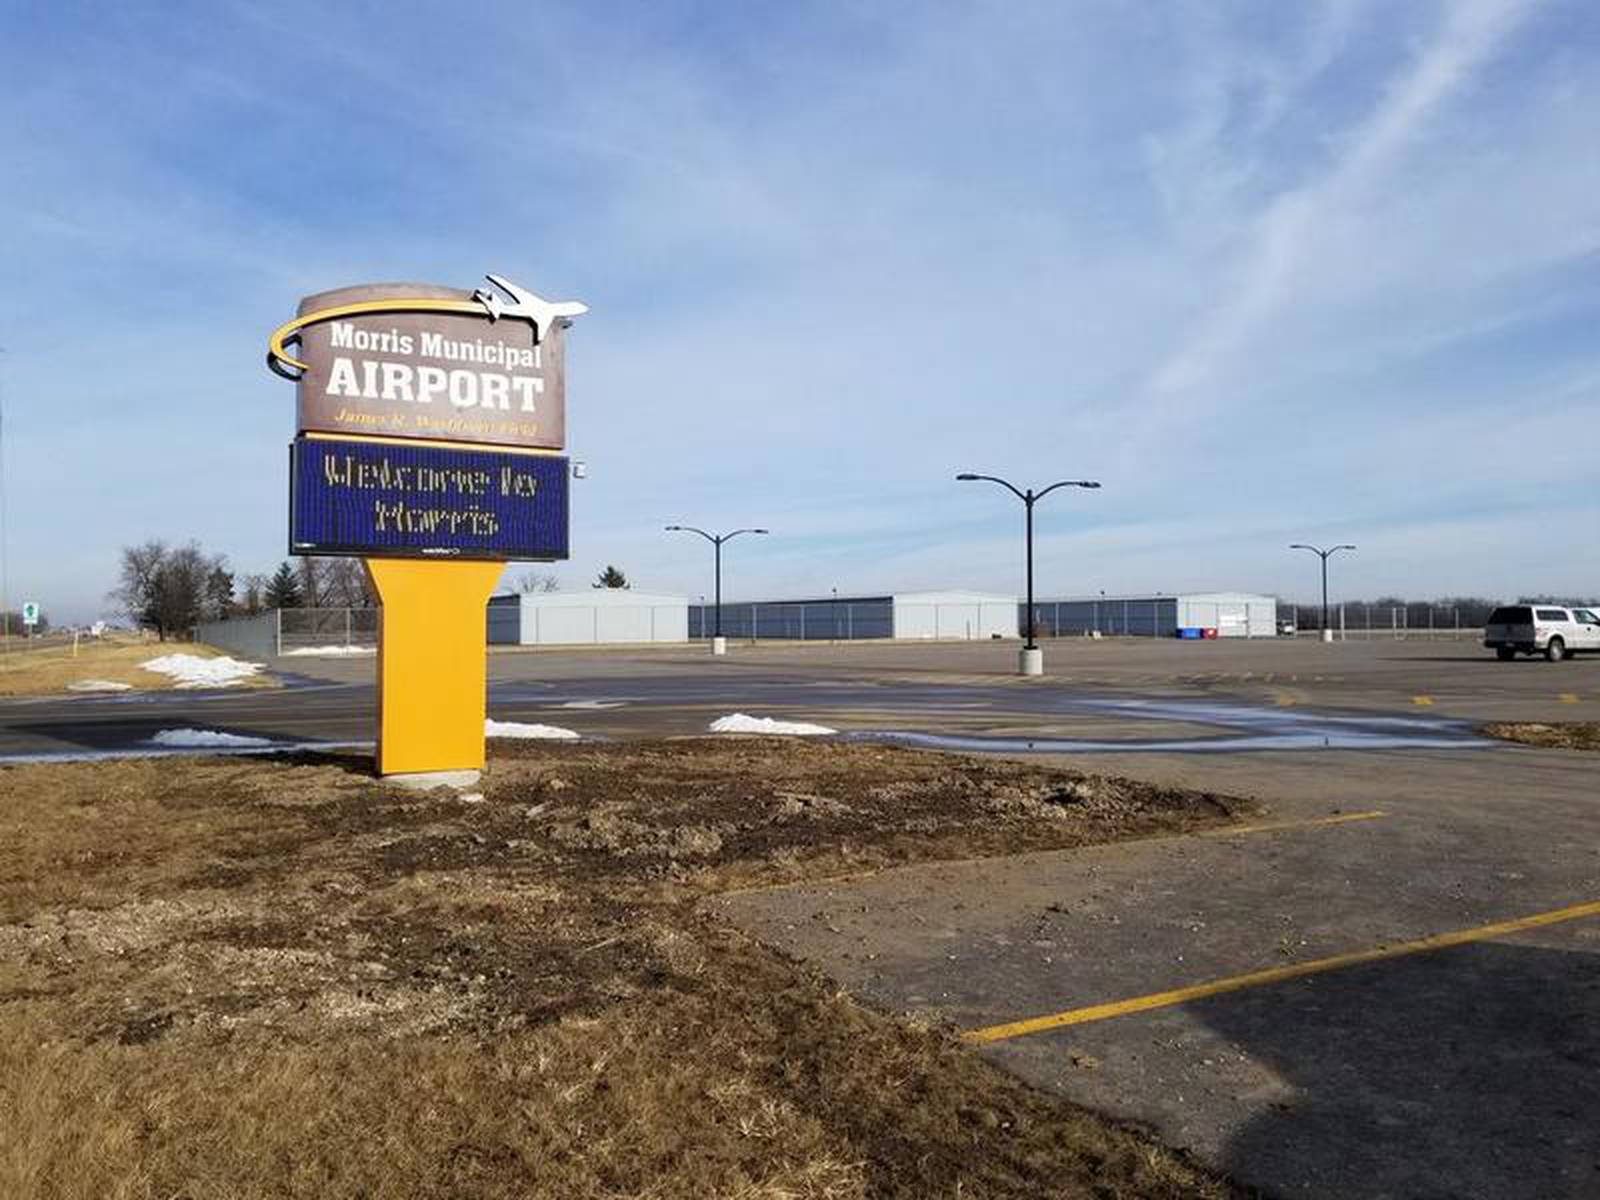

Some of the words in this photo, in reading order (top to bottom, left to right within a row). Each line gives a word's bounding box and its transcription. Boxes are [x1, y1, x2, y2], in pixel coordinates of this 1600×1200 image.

[331, 322, 413, 354] Morris
[421, 333, 541, 369] Municipal
[325, 358, 544, 412] AIRPORT
